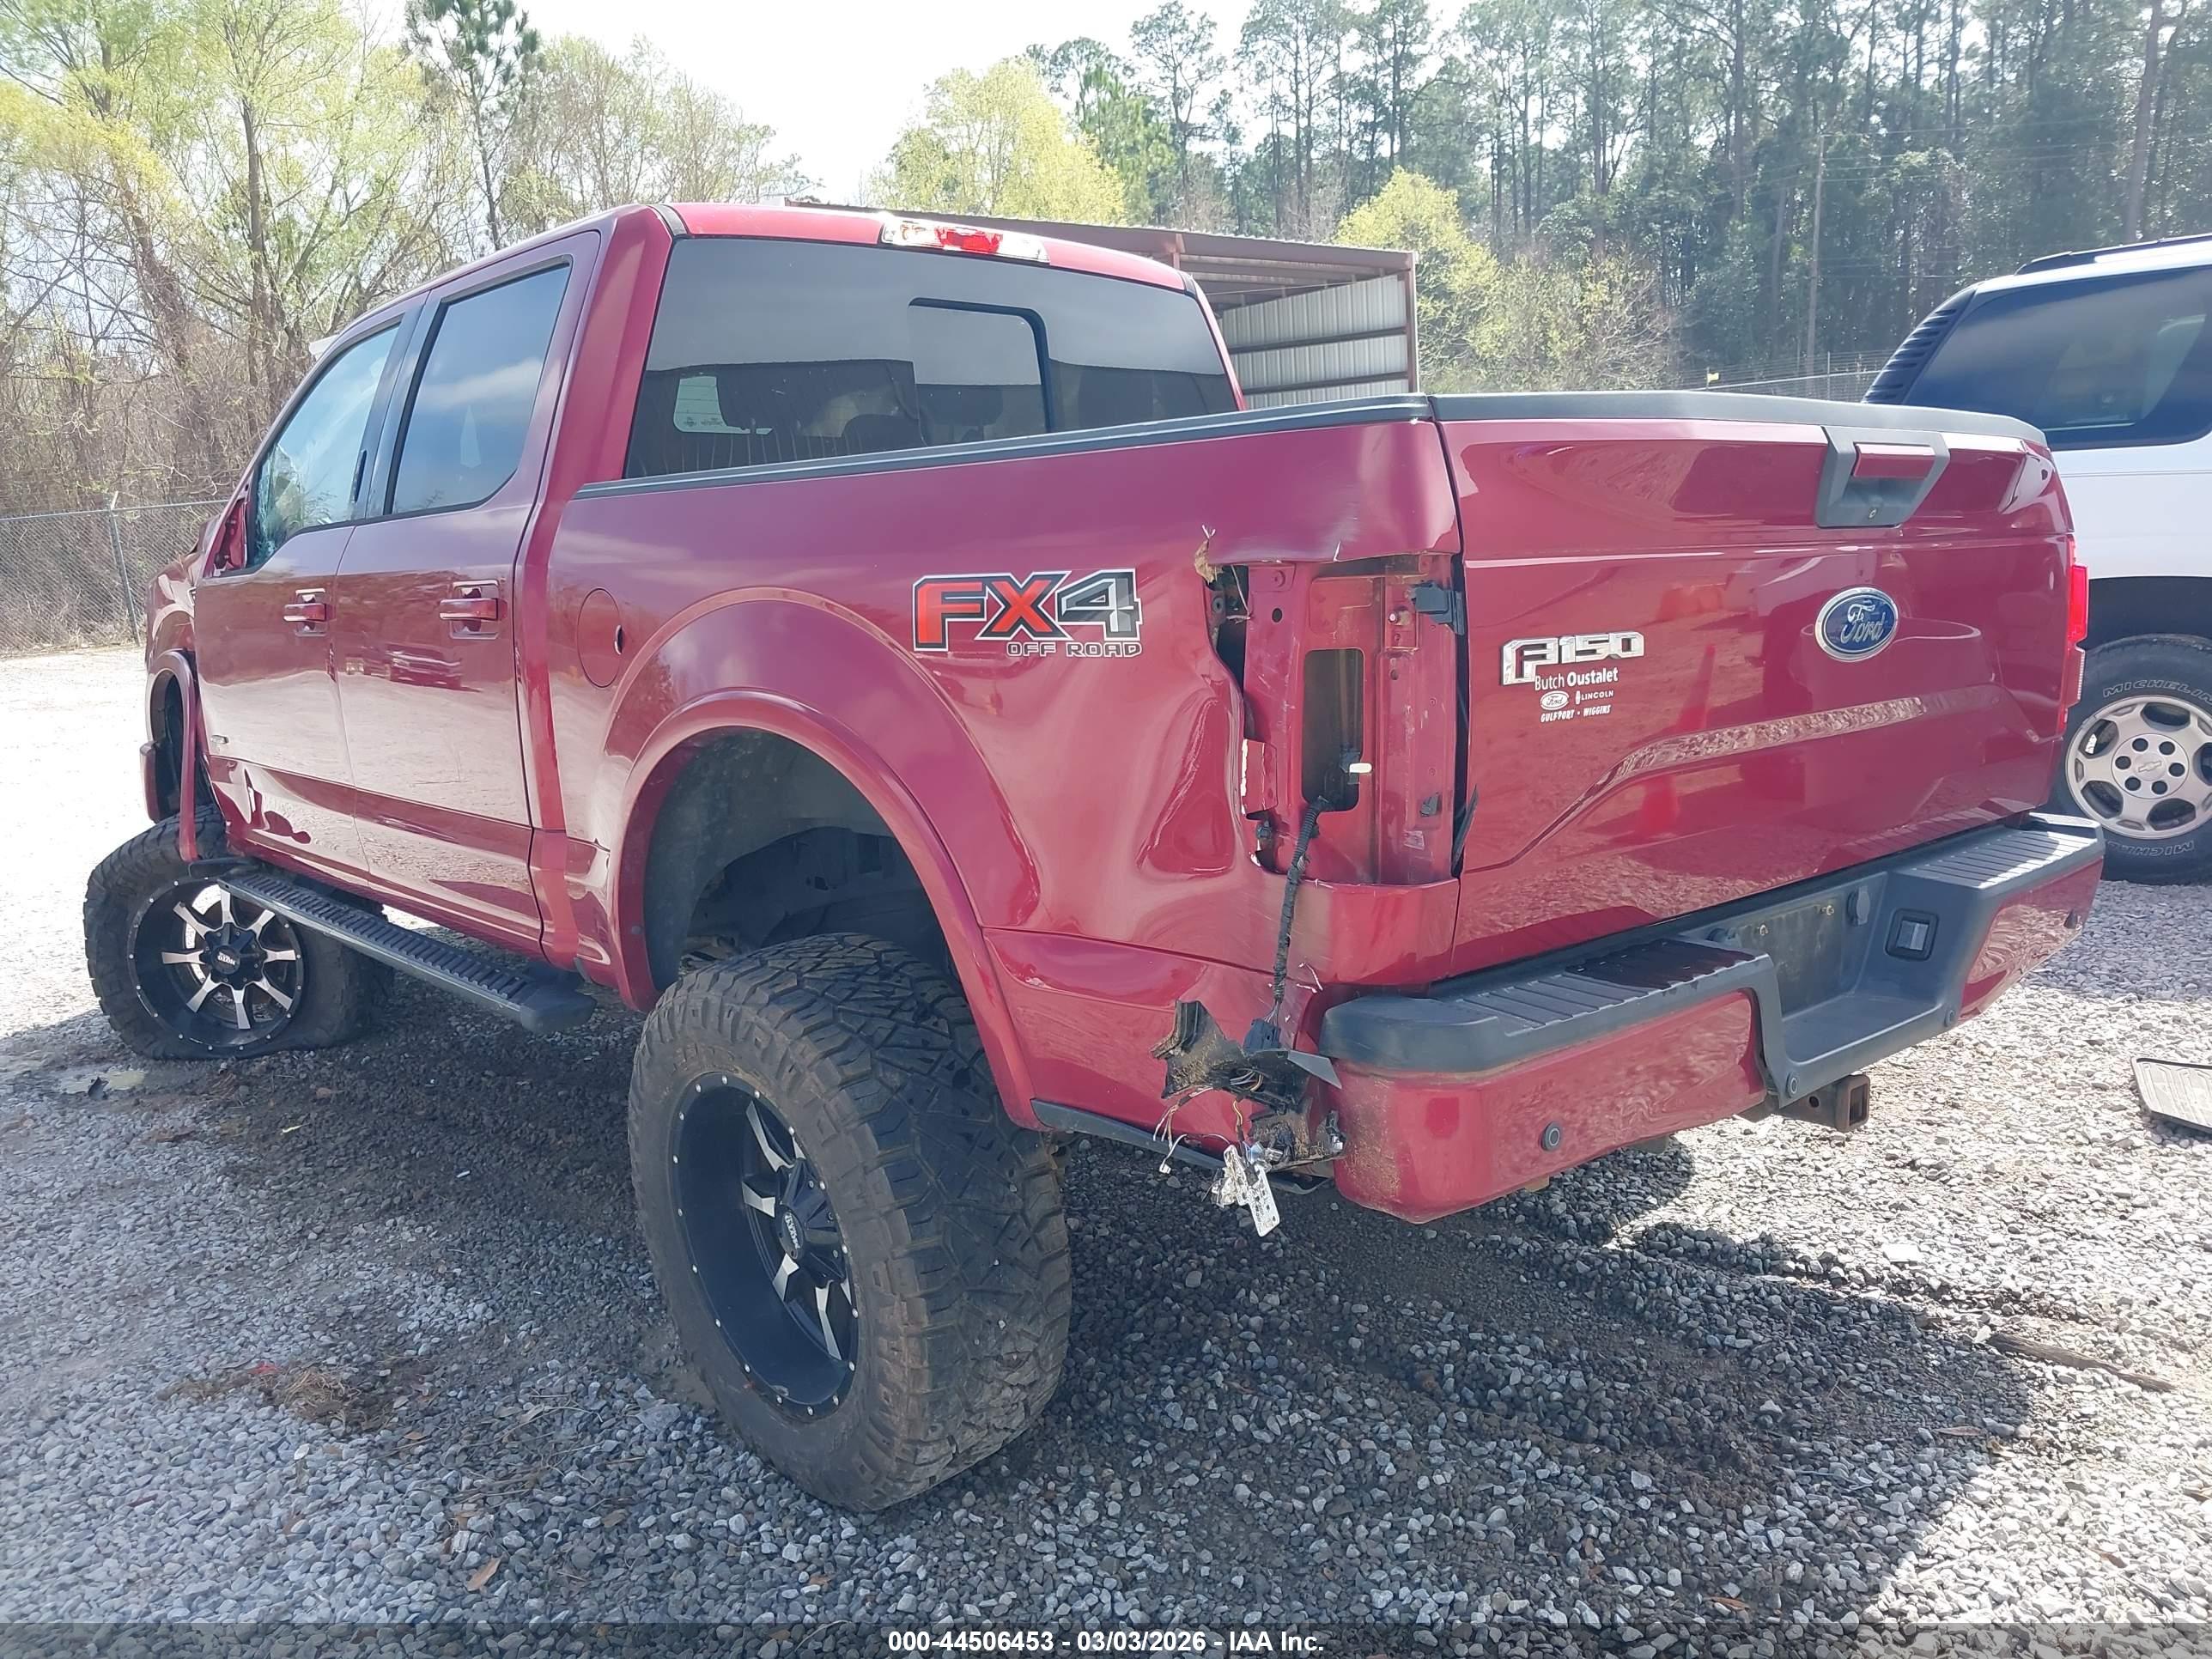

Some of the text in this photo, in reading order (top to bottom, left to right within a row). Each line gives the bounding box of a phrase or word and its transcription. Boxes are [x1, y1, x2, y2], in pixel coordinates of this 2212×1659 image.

[912, 568, 1143, 652] FX4
[1006, 641, 1143, 658] OFF ROAD
[1534, 666, 1619, 690] Butch Oustalet
[1581, 690, 1614, 701] LINCOLN
[1540, 704, 1612, 723] GULFPORT WIGGINS
